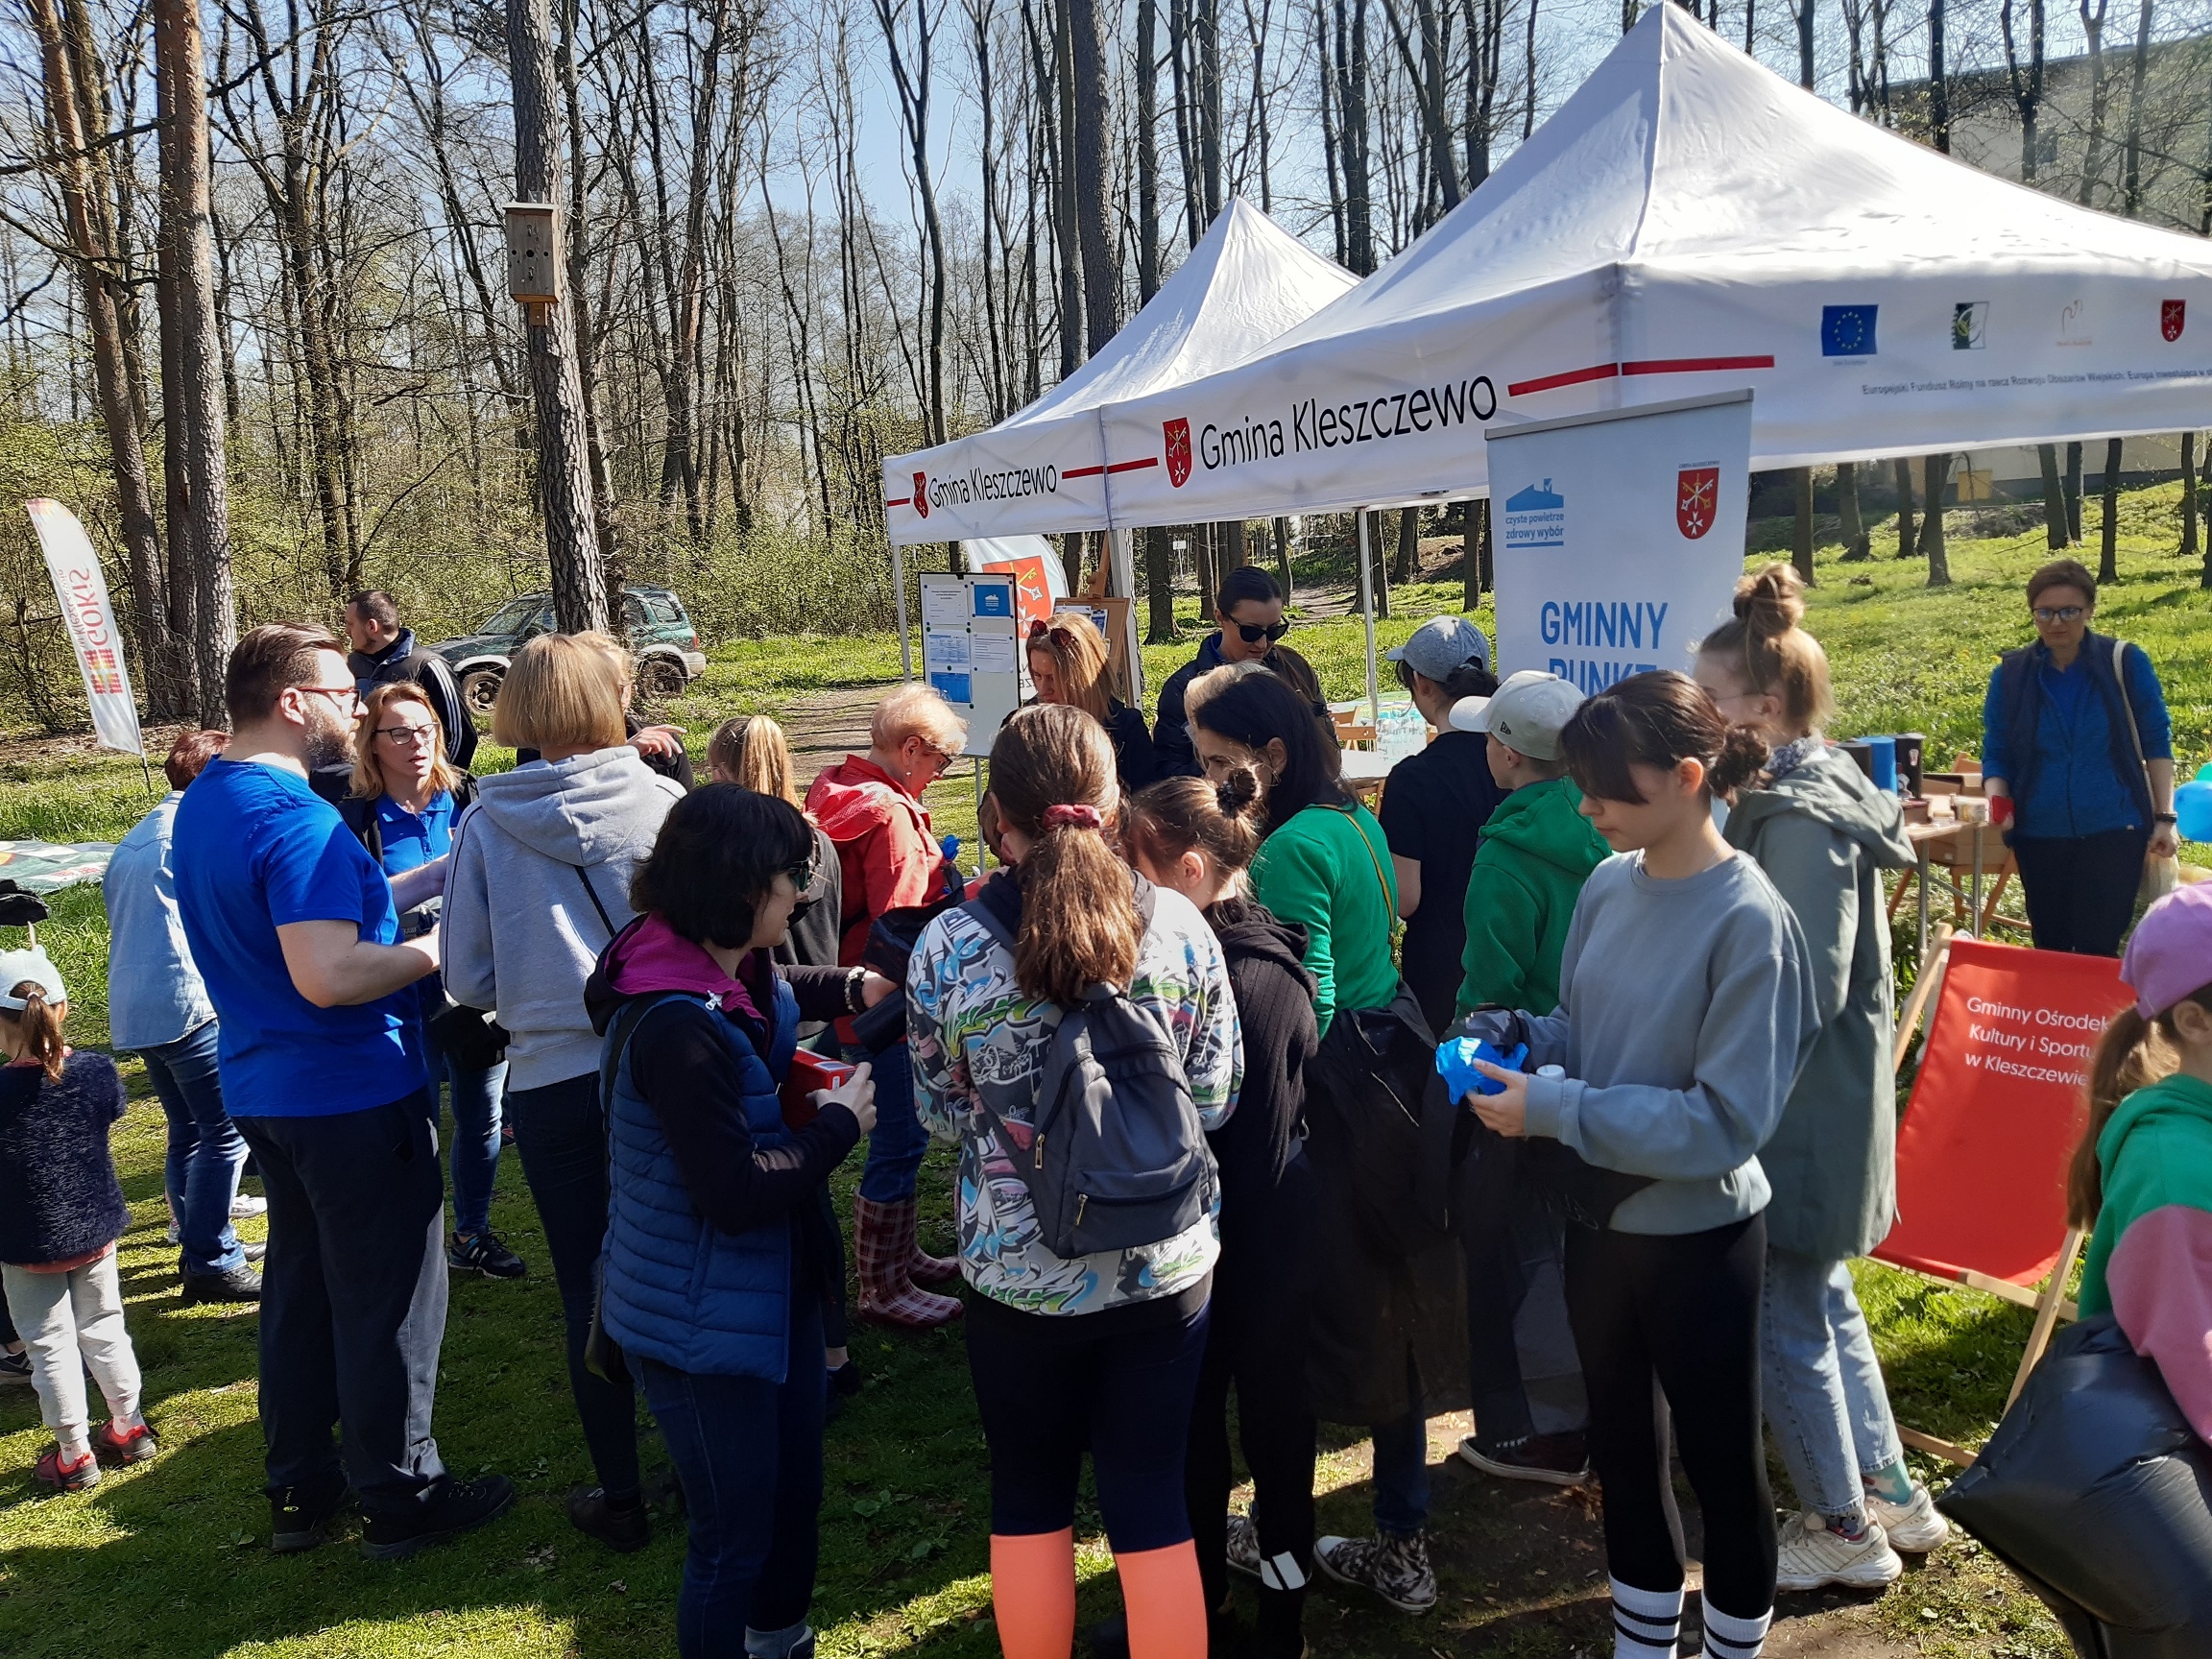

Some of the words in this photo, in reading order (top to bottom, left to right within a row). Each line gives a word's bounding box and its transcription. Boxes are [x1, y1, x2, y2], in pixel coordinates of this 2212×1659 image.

[1200, 415, 1285, 469] Gmina
[1292, 375, 1497, 453] Kleszczewo
[928, 474, 971, 509] Gmina
[970, 465, 1057, 502] Kleszczewo
[1505, 513, 1527, 525] czyste
[1528, 512, 1565, 525] powietrze
[1505, 527, 1536, 541] zdrowy
[1537, 525, 1564, 541] wybór
[1540, 601, 1669, 650] GMINNY
[1549, 658, 1657, 697] PUNK
[1967, 997, 2032, 1024] Gminny
[2035, 1007, 2108, 1032] Ośrodek
[1969, 1023, 2027, 1051] Kultury
[2030, 1035, 2036, 1050] i
[1965, 1053, 1982, 1068] w
[1984, 1055, 2089, 1086] Kleszczewie
